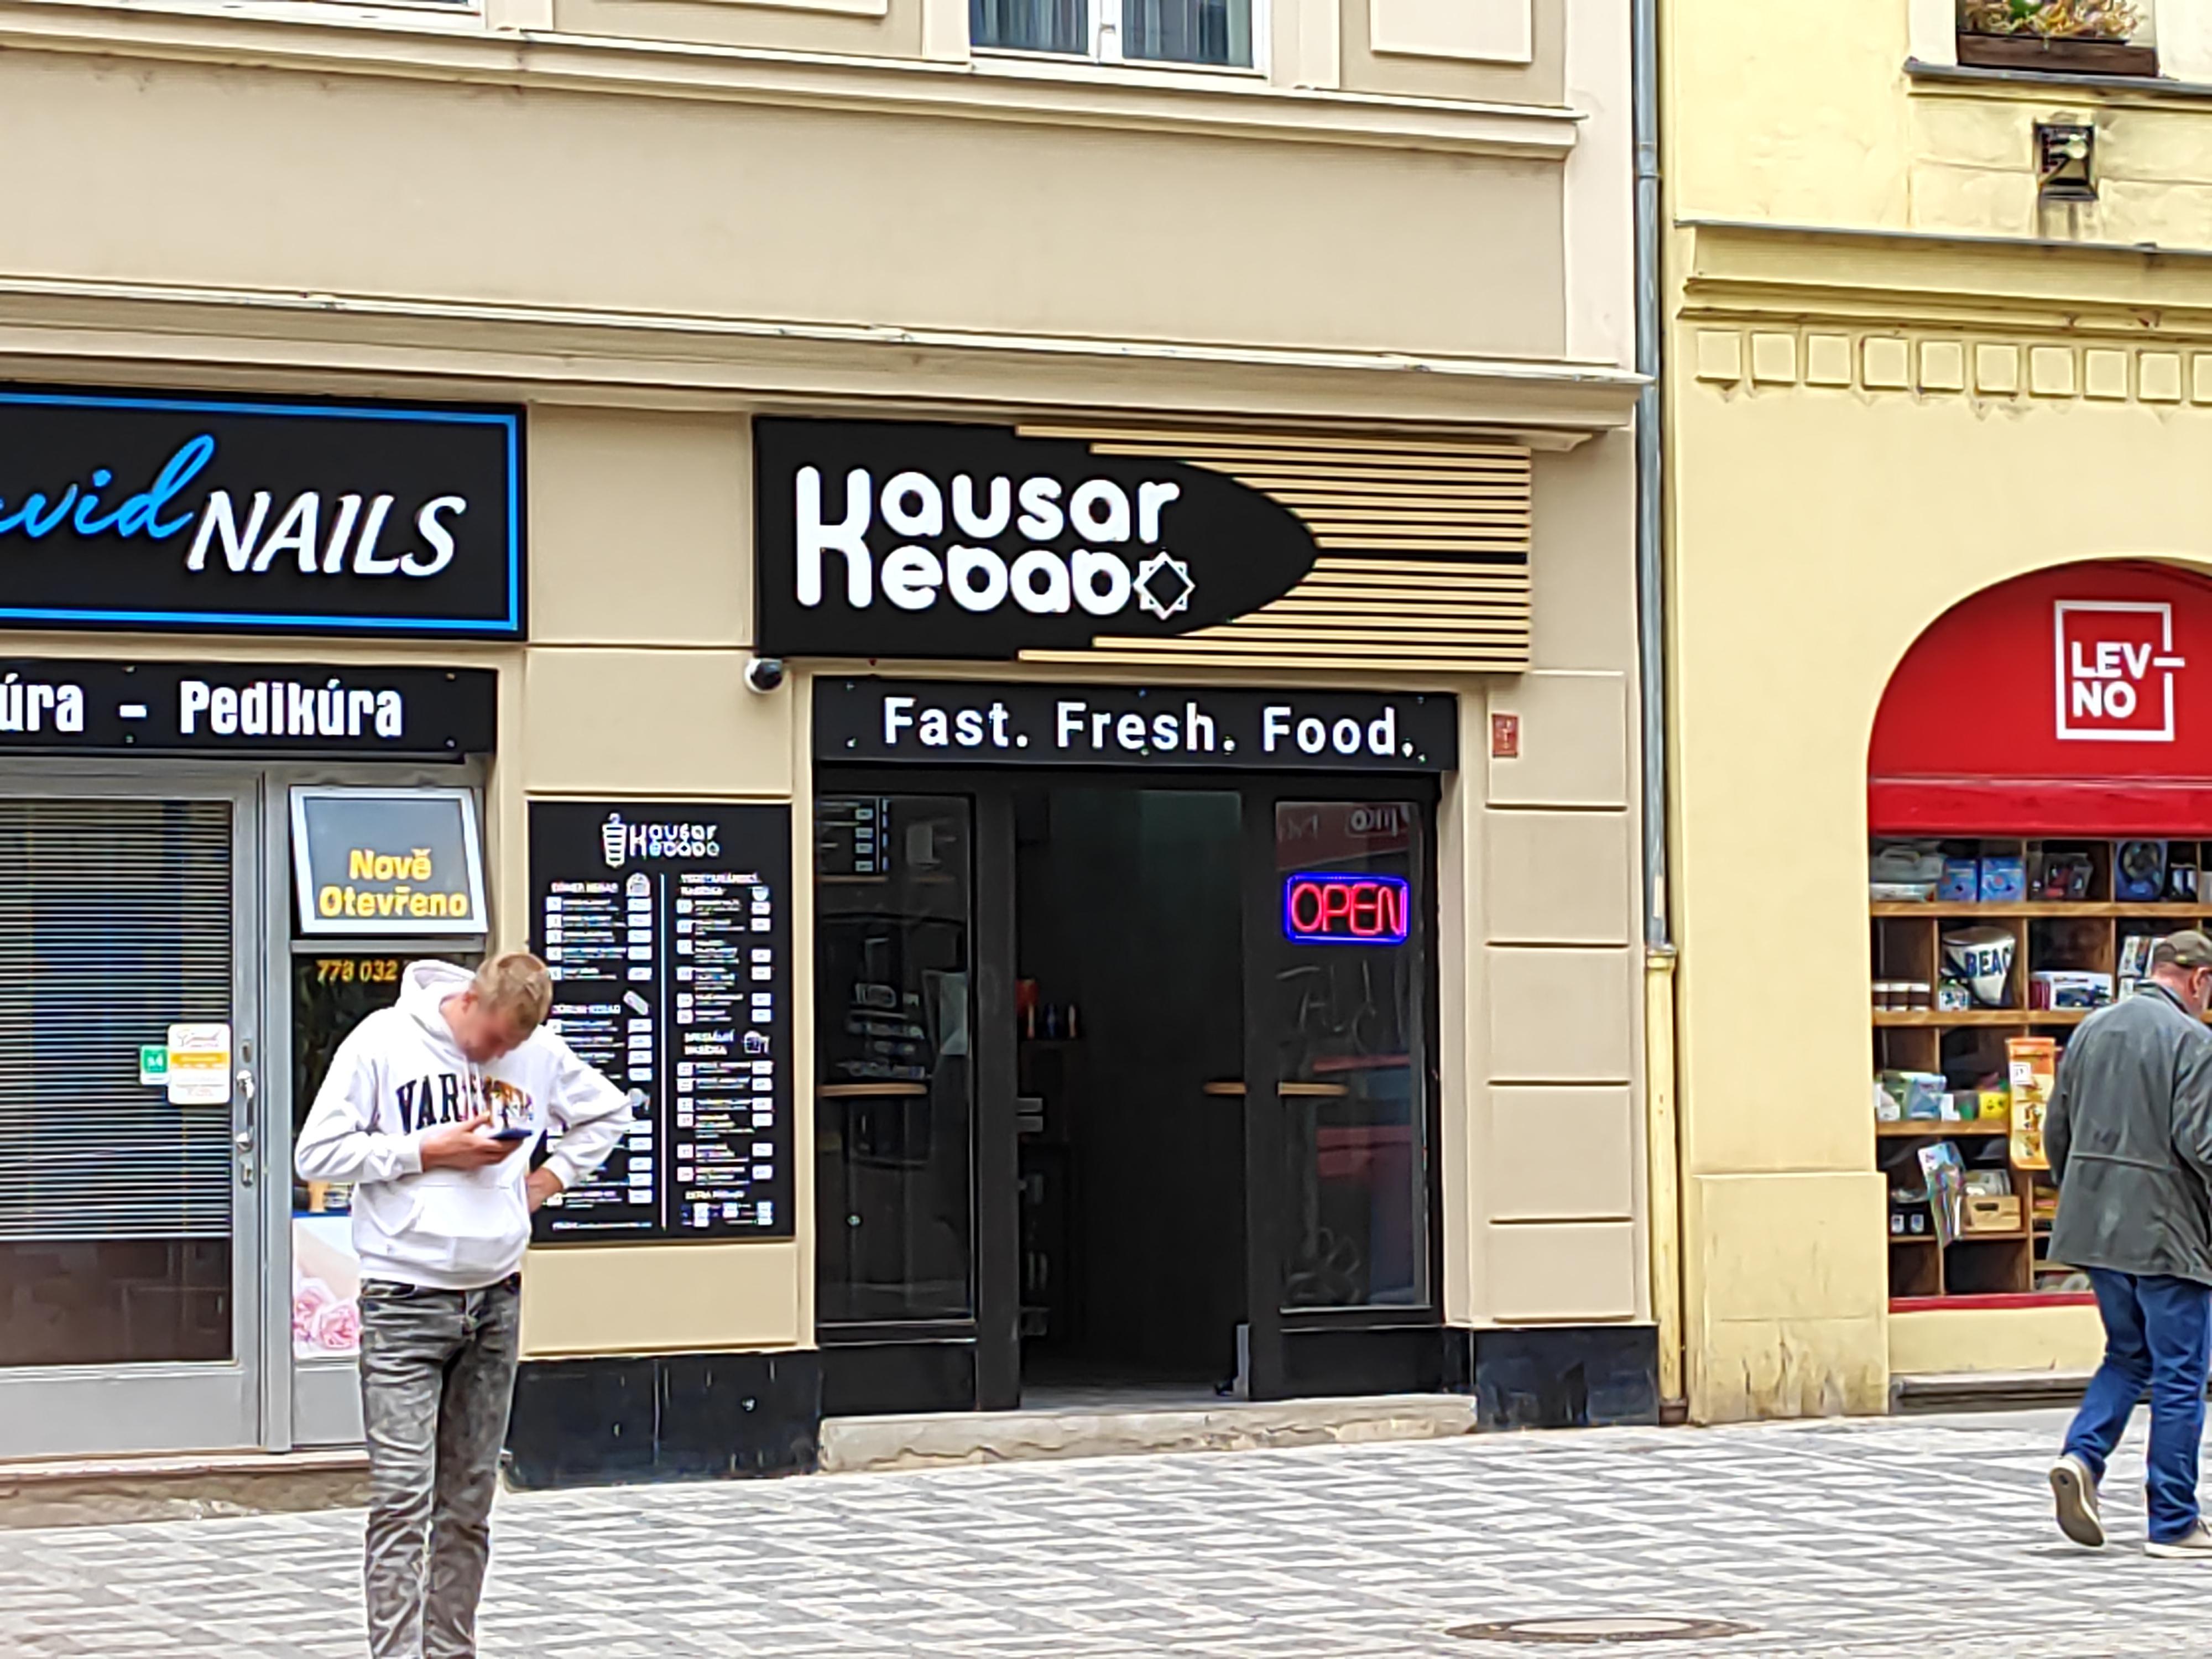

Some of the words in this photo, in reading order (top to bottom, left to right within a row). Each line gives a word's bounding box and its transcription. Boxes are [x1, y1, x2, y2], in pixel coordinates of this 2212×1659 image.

[186, 489, 467, 577] NAILS
[179, 678, 403, 737] Pedikúra
[2072, 680, 2137, 719] NO
[883, 696, 1030, 748] Fast.
[1056, 701, 1237, 753] Fresh.
[1262, 707, 1415, 758] Food.
[349, 848, 432, 881] Nově
[319, 885, 468, 917] Otevřeno
[1291, 882, 1407, 936] OPEN
[359, 959, 398, 983] 032
